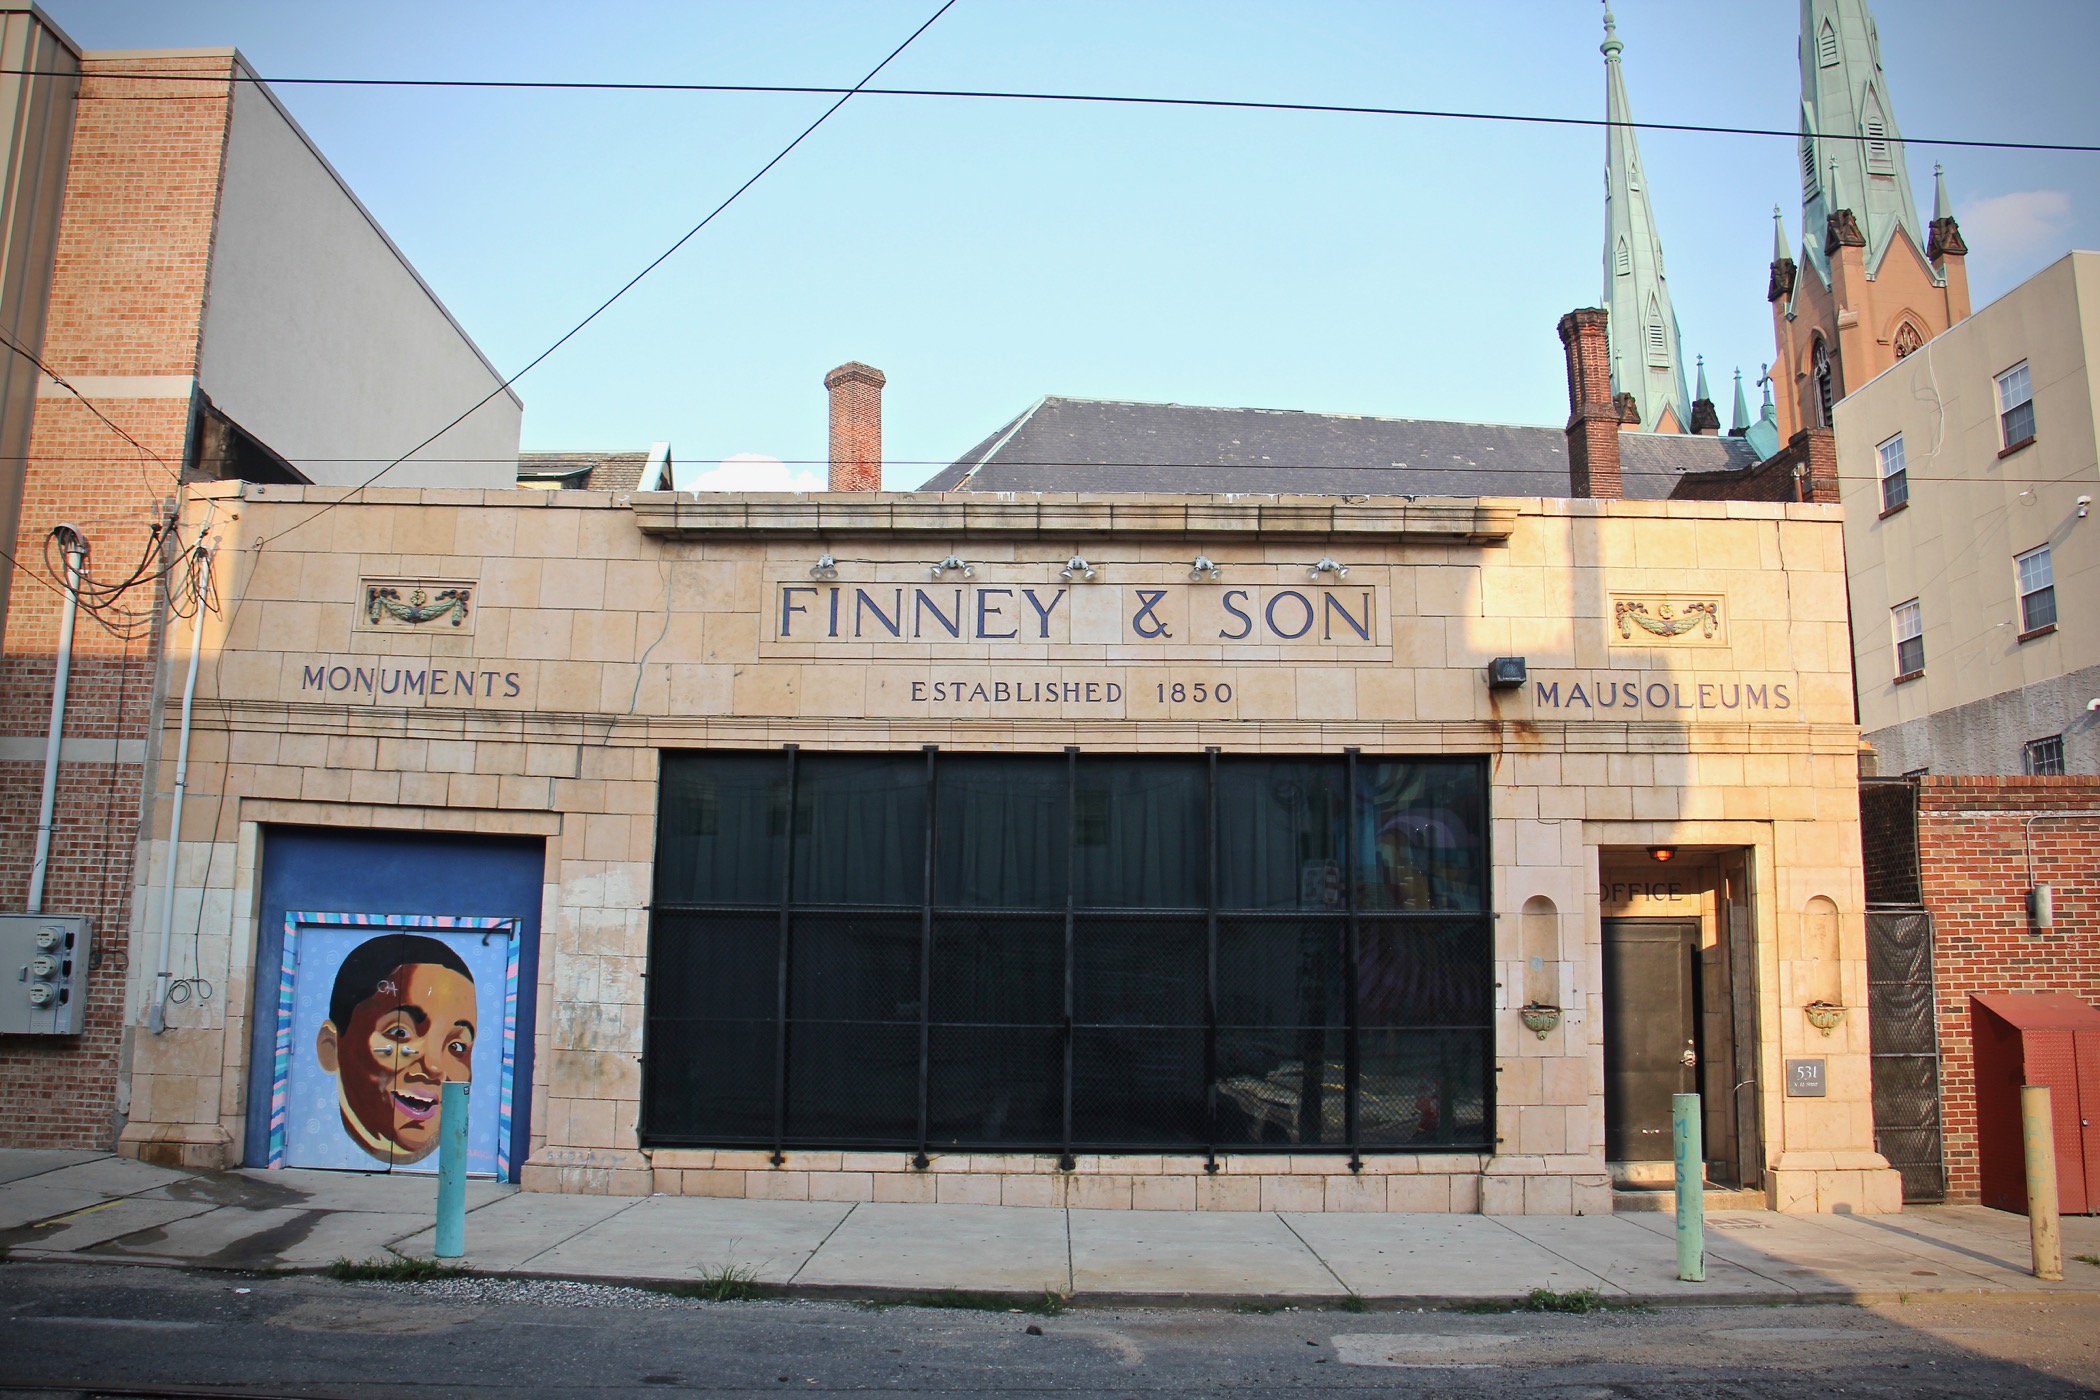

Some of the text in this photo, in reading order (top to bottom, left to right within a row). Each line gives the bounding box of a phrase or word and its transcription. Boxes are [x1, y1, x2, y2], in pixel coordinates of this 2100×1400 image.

[780, 587, 1370, 641] FINNEY & SON
[302, 665, 521, 698] MONUMENTS
[911, 681, 1233, 704] ESTABLISHED 1850
[1536, 682, 1791, 710] MAUSOLEUMS
[1797, 1065, 1817, 1080] 531
[1674, 1118, 1687, 1231] MUSIC
